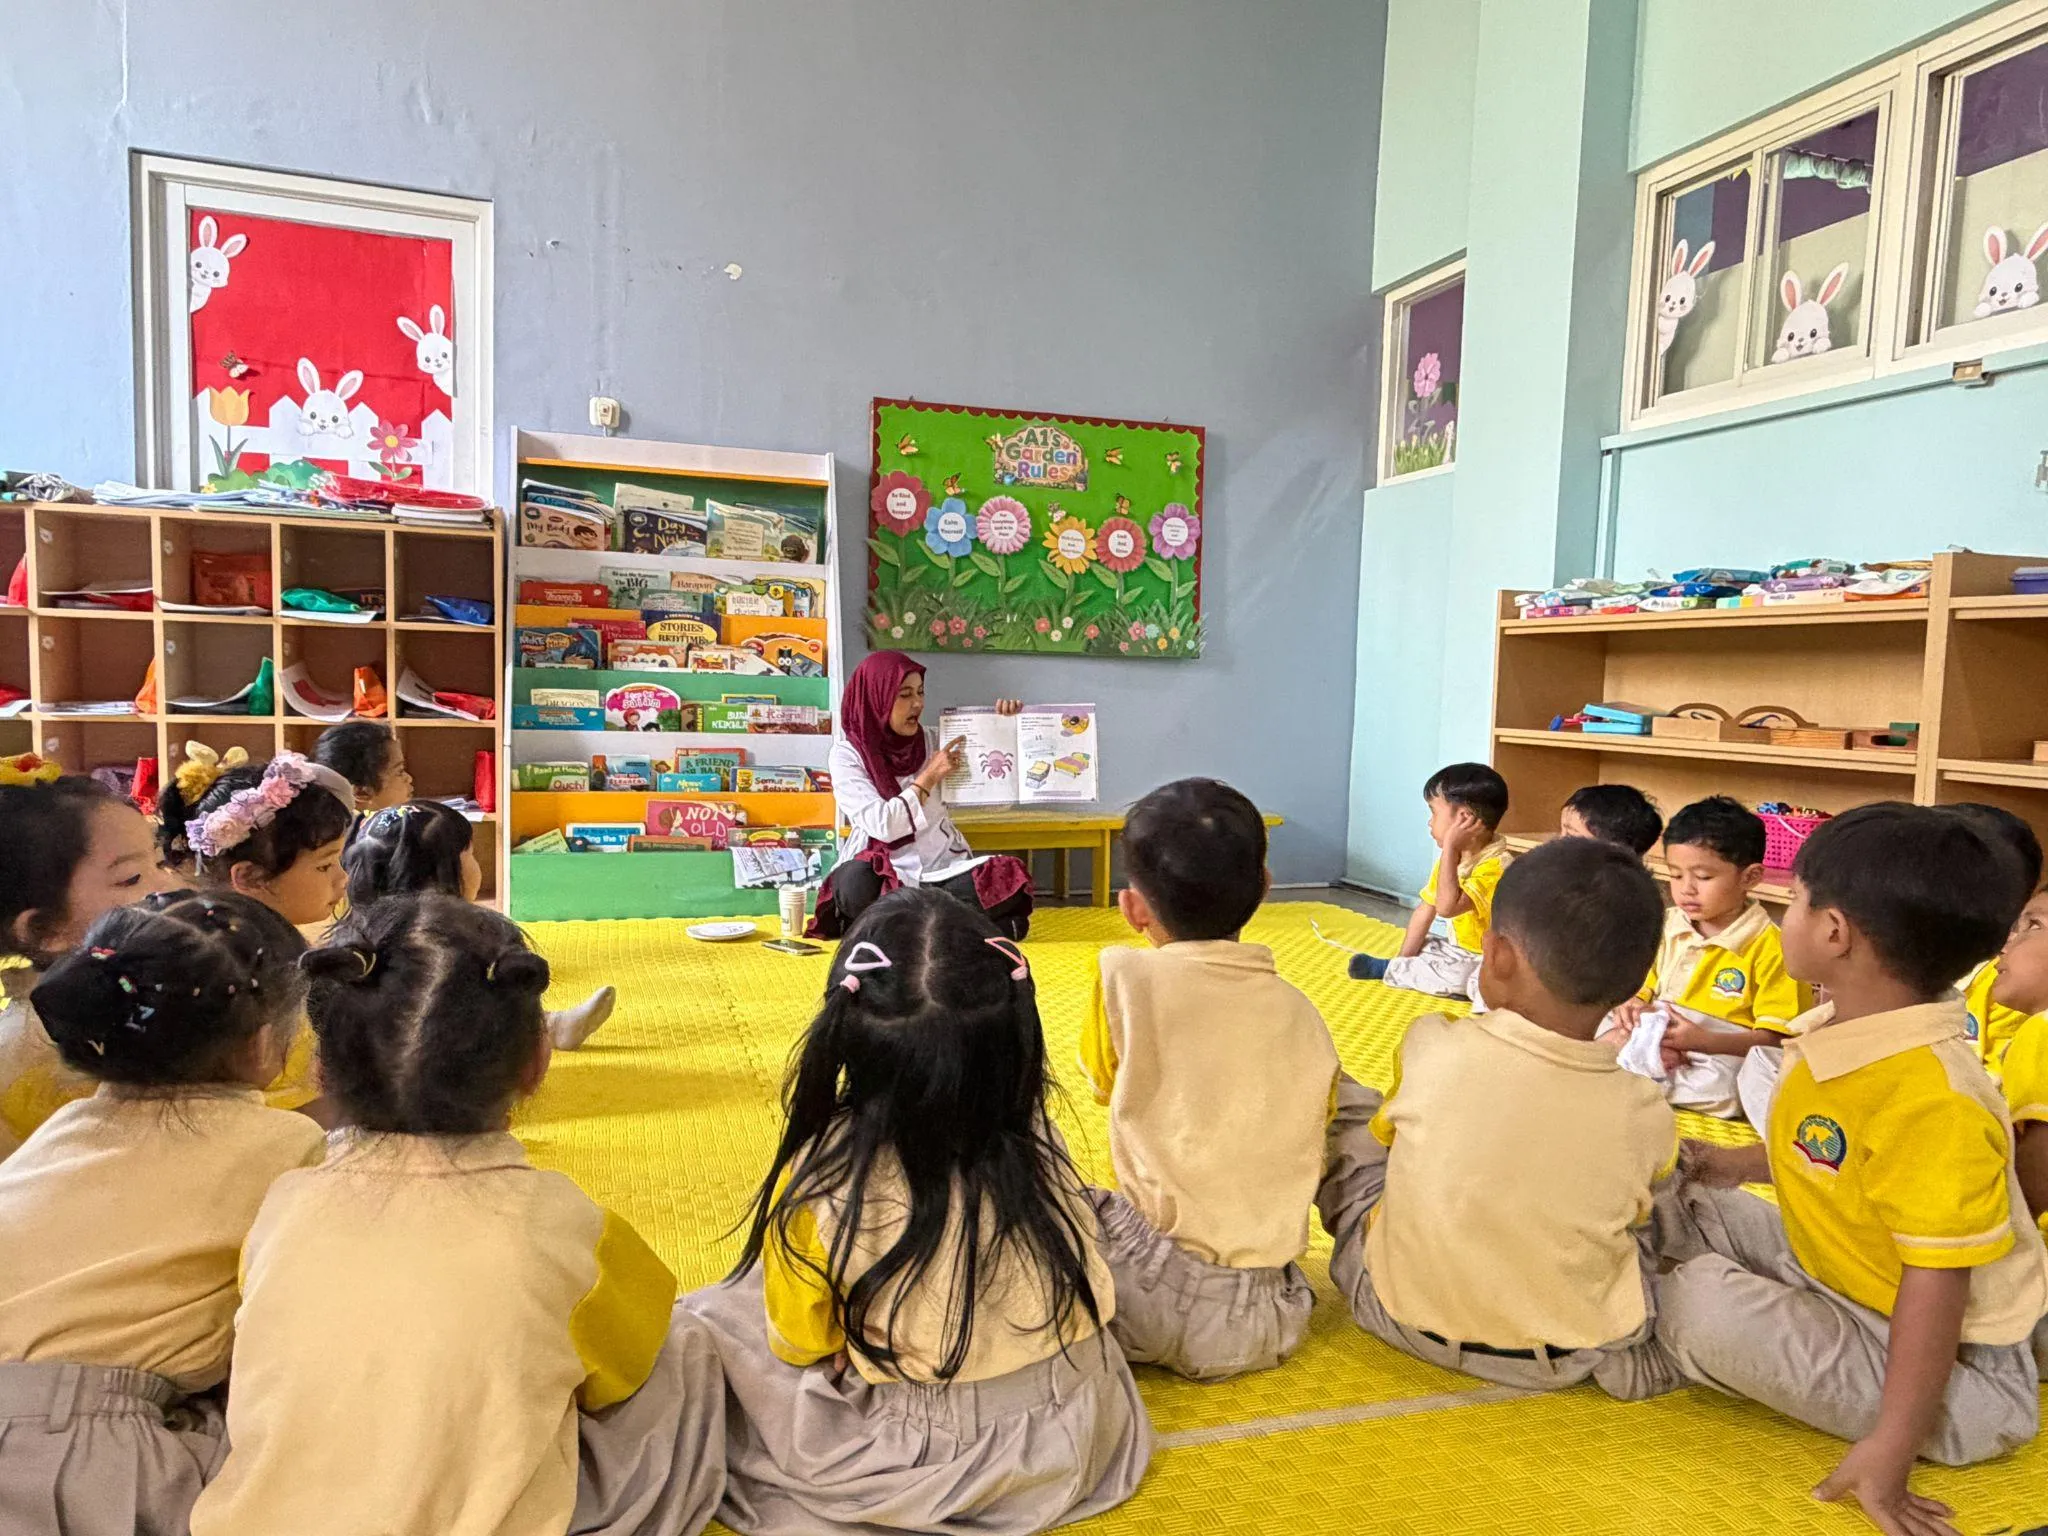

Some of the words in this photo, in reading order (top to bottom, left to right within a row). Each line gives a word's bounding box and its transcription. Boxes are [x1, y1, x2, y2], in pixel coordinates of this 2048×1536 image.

[1023, 427, 1062, 447] A1's
[1004, 442, 1078, 466] Garden
[1017, 460, 1070, 481] Rules
[526, 521, 543, 532] My
[547, 523, 570, 536] Body
[658, 517, 686, 534] Day
[626, 577, 649, 589] BIG
[659, 621, 704, 633] STORIES
[658, 633, 706, 646] BEDTIME
[686, 760, 693, 768] A
[695, 757, 735, 767] FRIEND
[552, 779, 586, 791] Ouch!
[754, 776, 783, 785] Semut
[685, 806, 720, 821] NOT
[690, 821, 727, 838] OLD
[602, 834, 617, 843] the
